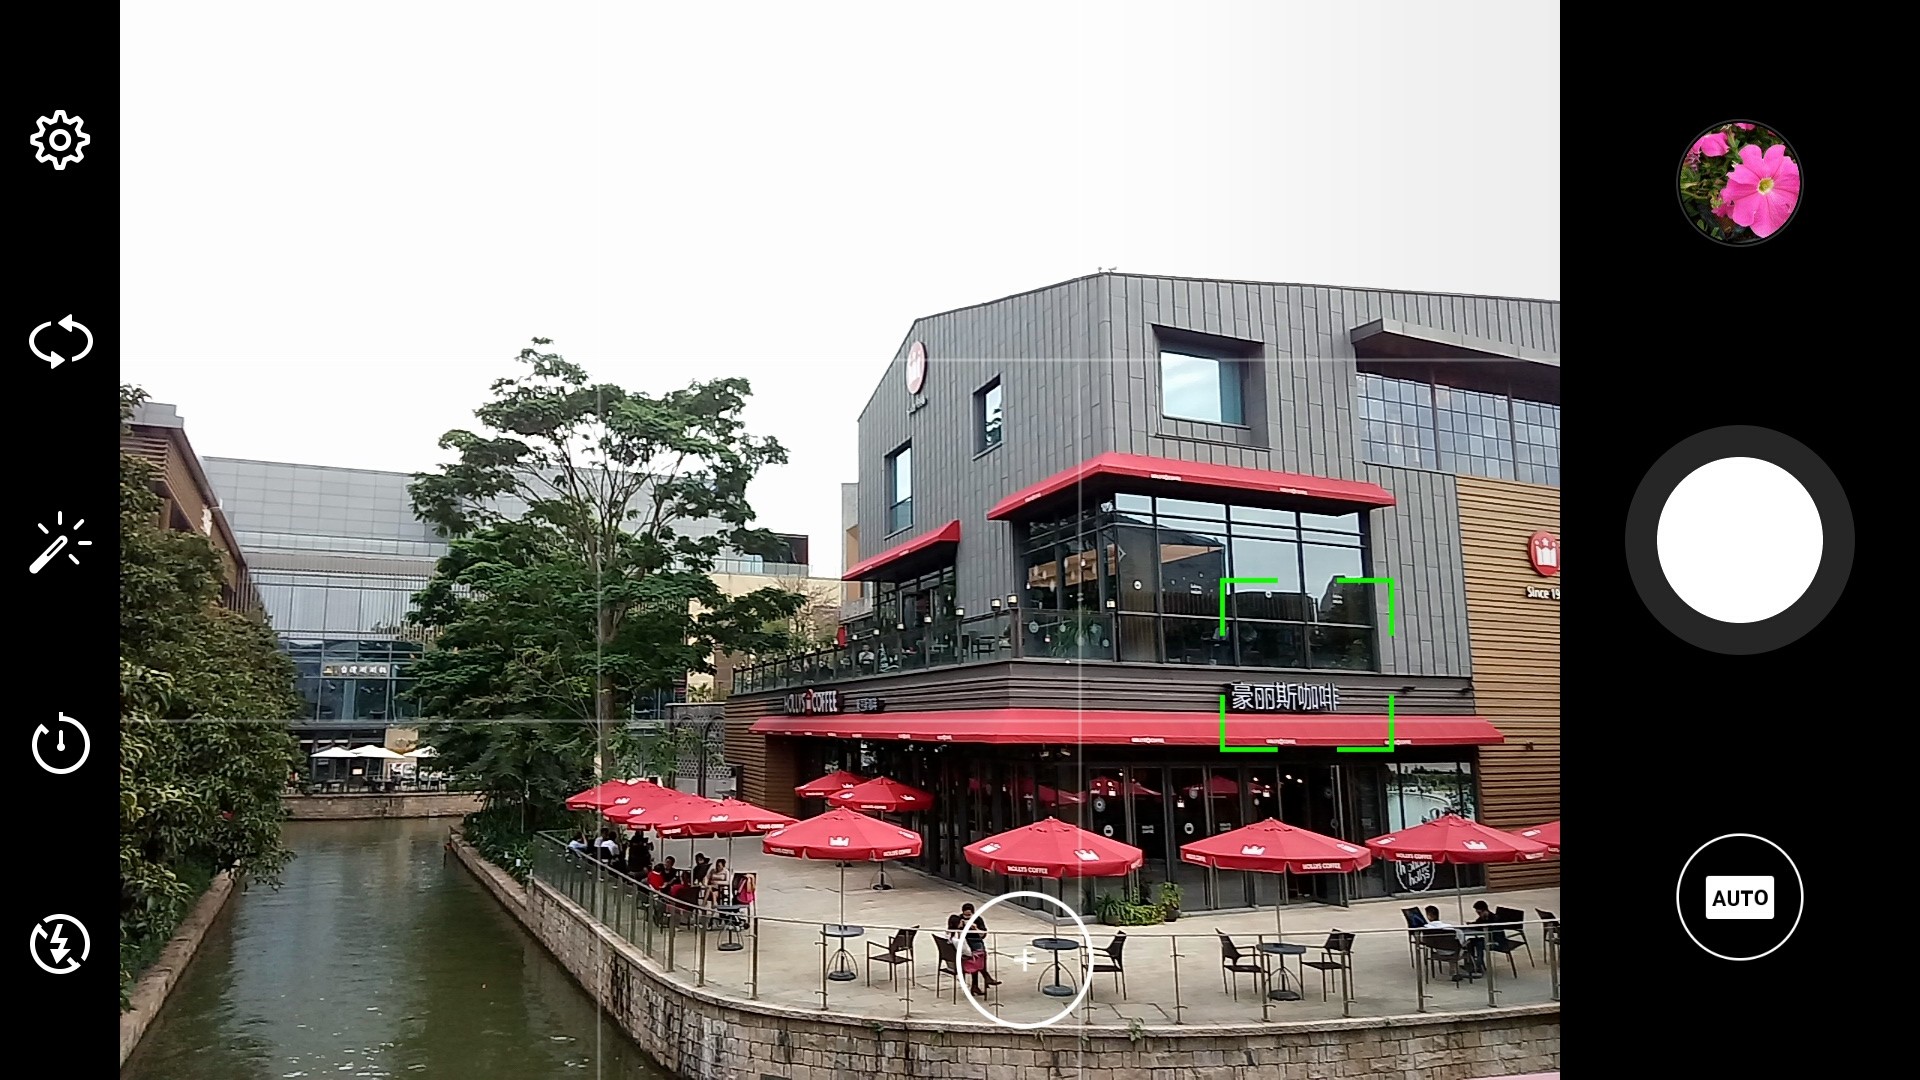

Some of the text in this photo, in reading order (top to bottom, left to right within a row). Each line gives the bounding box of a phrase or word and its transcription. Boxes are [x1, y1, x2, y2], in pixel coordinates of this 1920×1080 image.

[1526, 585, 1550, 599] Since
[784, 693, 806, 714] HOLLYS
[811, 690, 838, 713] COFFEE
[1231, 682, 1340, 712] 豪丽斯咖啡
